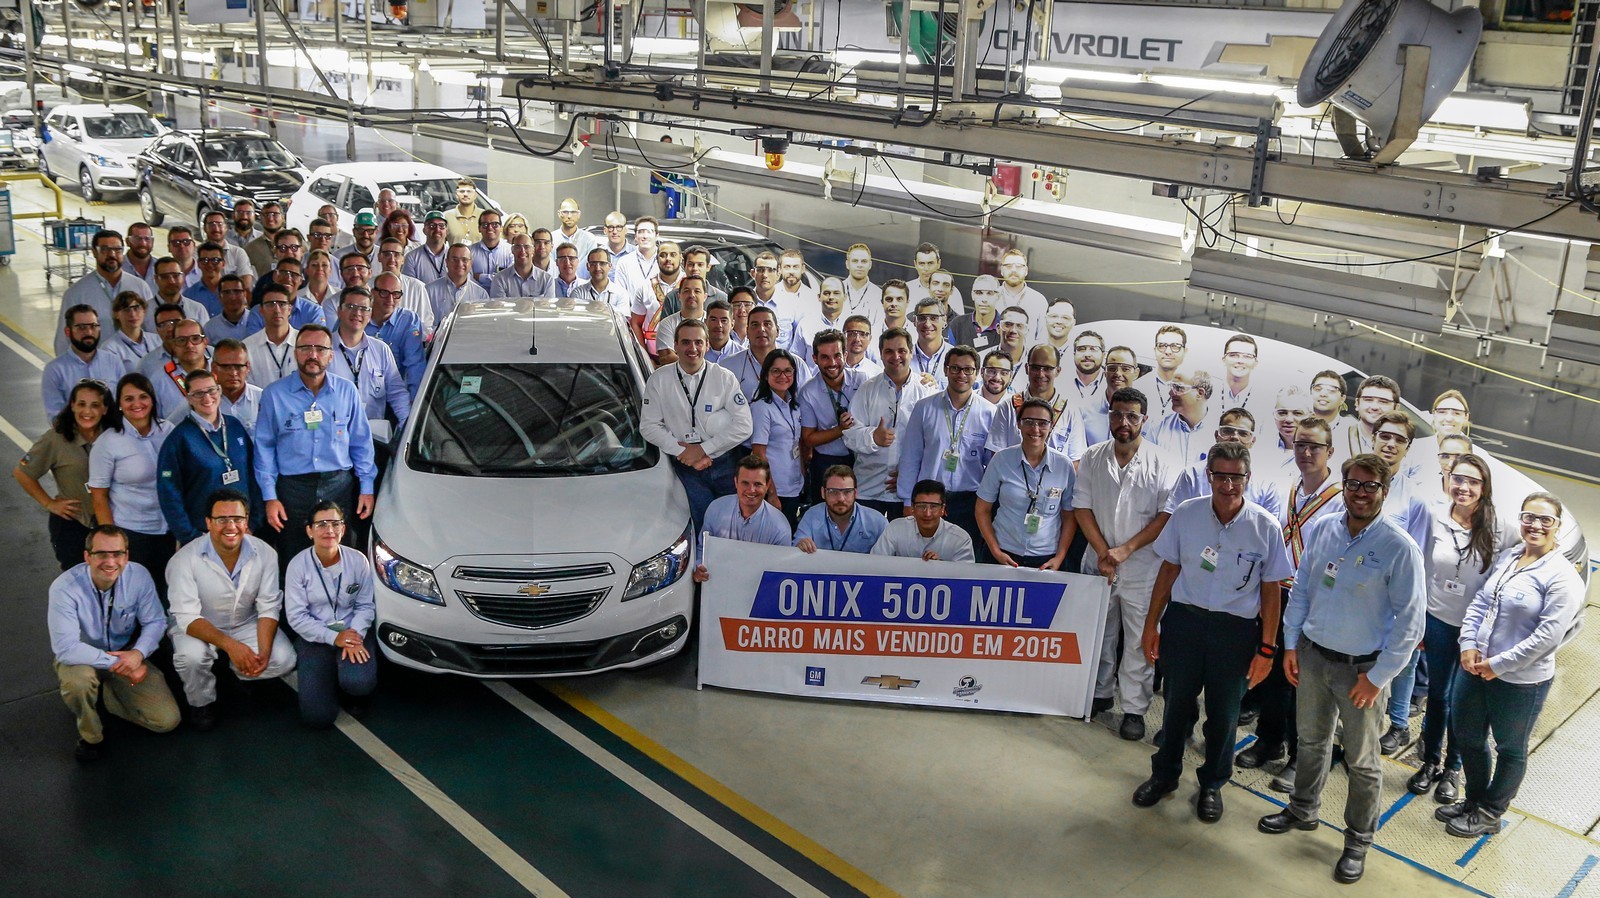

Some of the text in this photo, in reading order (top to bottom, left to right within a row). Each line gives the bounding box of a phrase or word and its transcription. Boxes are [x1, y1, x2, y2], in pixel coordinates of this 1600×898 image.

[778, 578, 1033, 624] ONIX 500 MIL
[737, 624, 1063, 660] CARRO MAIS VENDIDO EM 2015
[809, 670, 822, 680] GM
